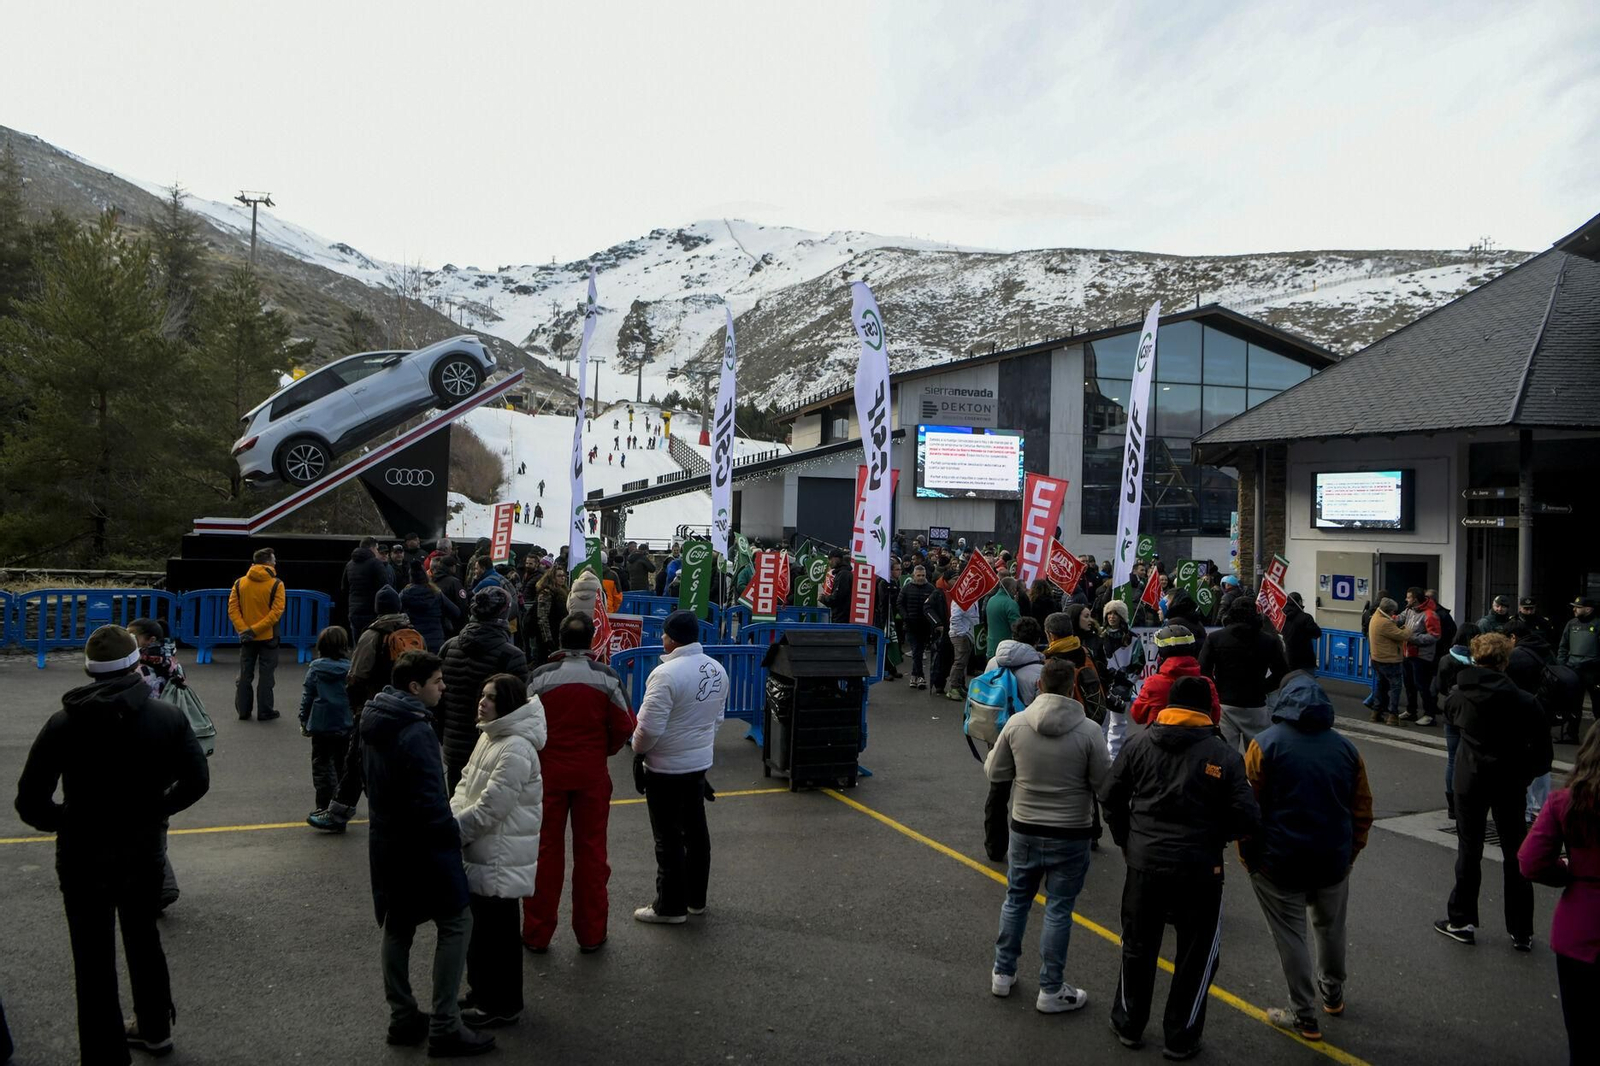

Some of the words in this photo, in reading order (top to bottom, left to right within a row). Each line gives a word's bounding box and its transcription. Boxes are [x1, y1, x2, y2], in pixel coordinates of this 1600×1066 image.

[924, 385, 993, 398] sierranevada
[941, 402, 991, 413] DEKTON
[1126, 400, 1143, 504] CSIF
[493, 505, 511, 560] CCOO
[690, 550, 710, 559] CSIF
[757, 554, 775, 613] CCOO
